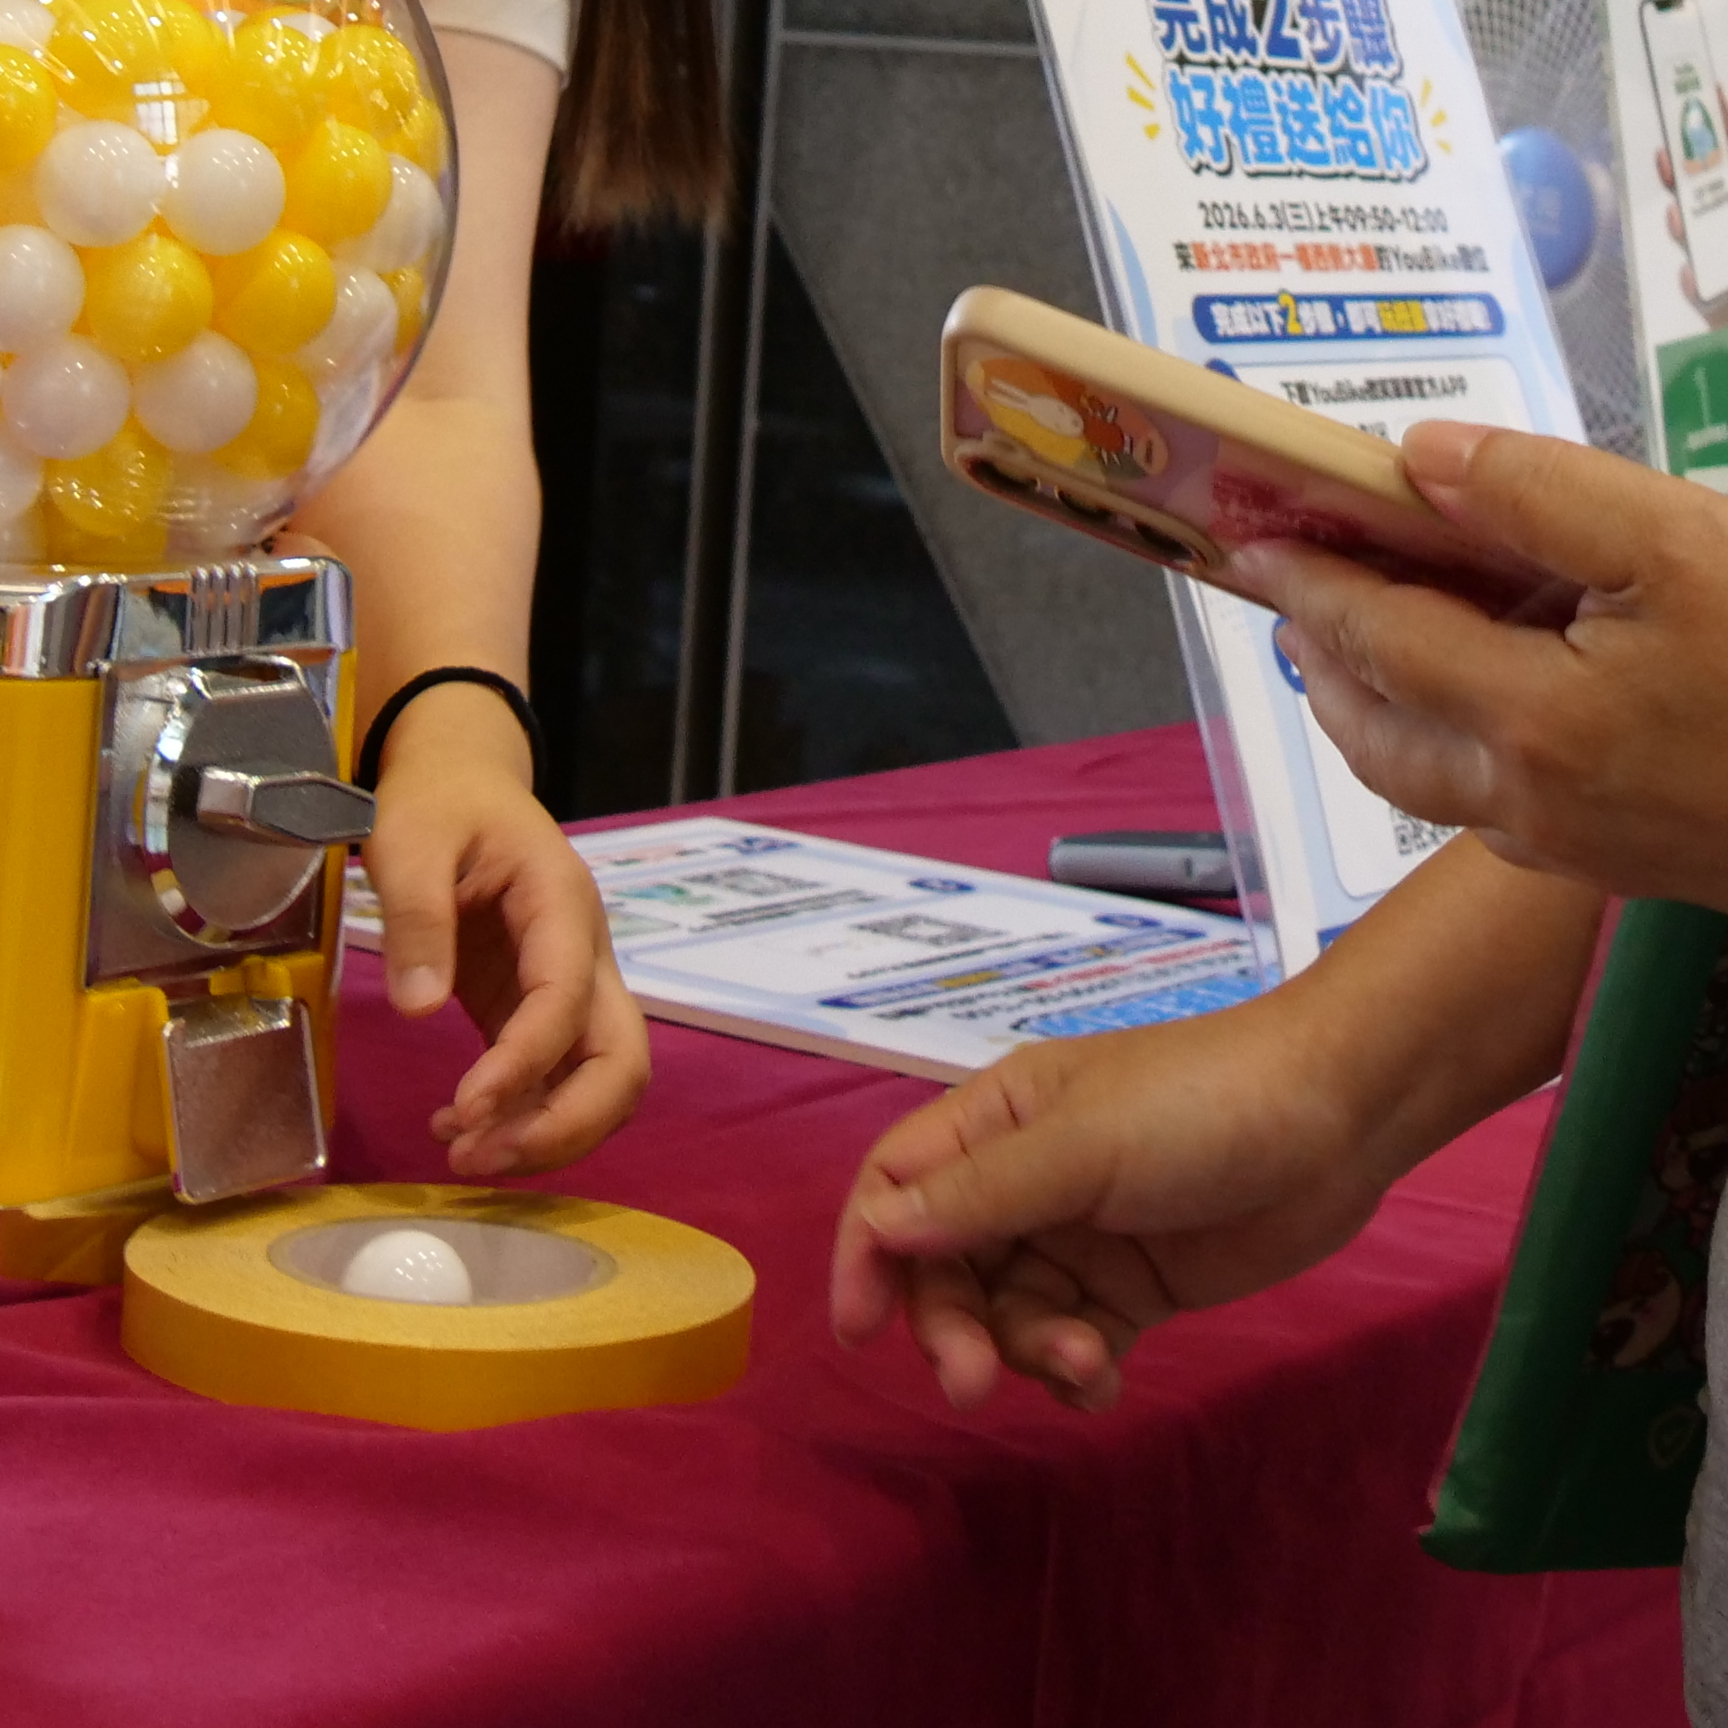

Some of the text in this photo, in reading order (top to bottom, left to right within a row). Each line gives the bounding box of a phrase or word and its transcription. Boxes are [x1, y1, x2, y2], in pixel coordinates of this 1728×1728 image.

[1168, 69, 1423, 174] 好禮送給你
